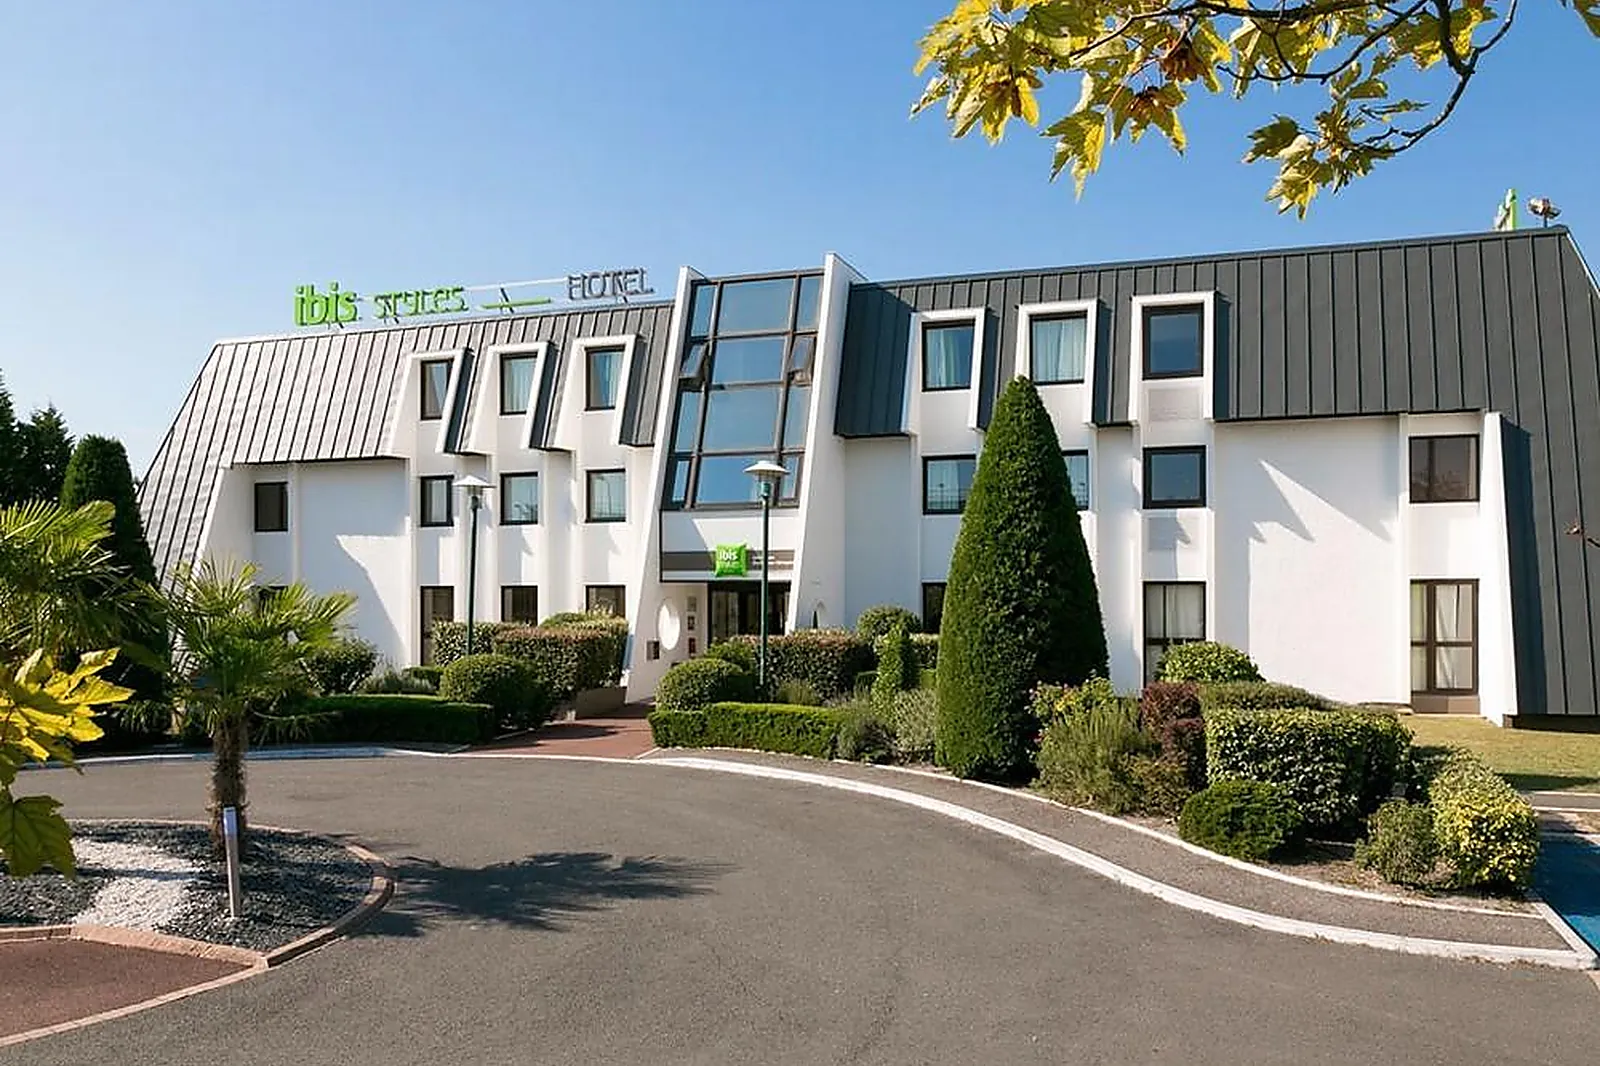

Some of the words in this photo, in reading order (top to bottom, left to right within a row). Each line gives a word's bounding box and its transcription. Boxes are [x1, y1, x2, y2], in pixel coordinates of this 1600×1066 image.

[294, 281, 358, 326] ibis
[567, 267, 655, 300] HOTEL
[719, 549, 738, 561] ibis
